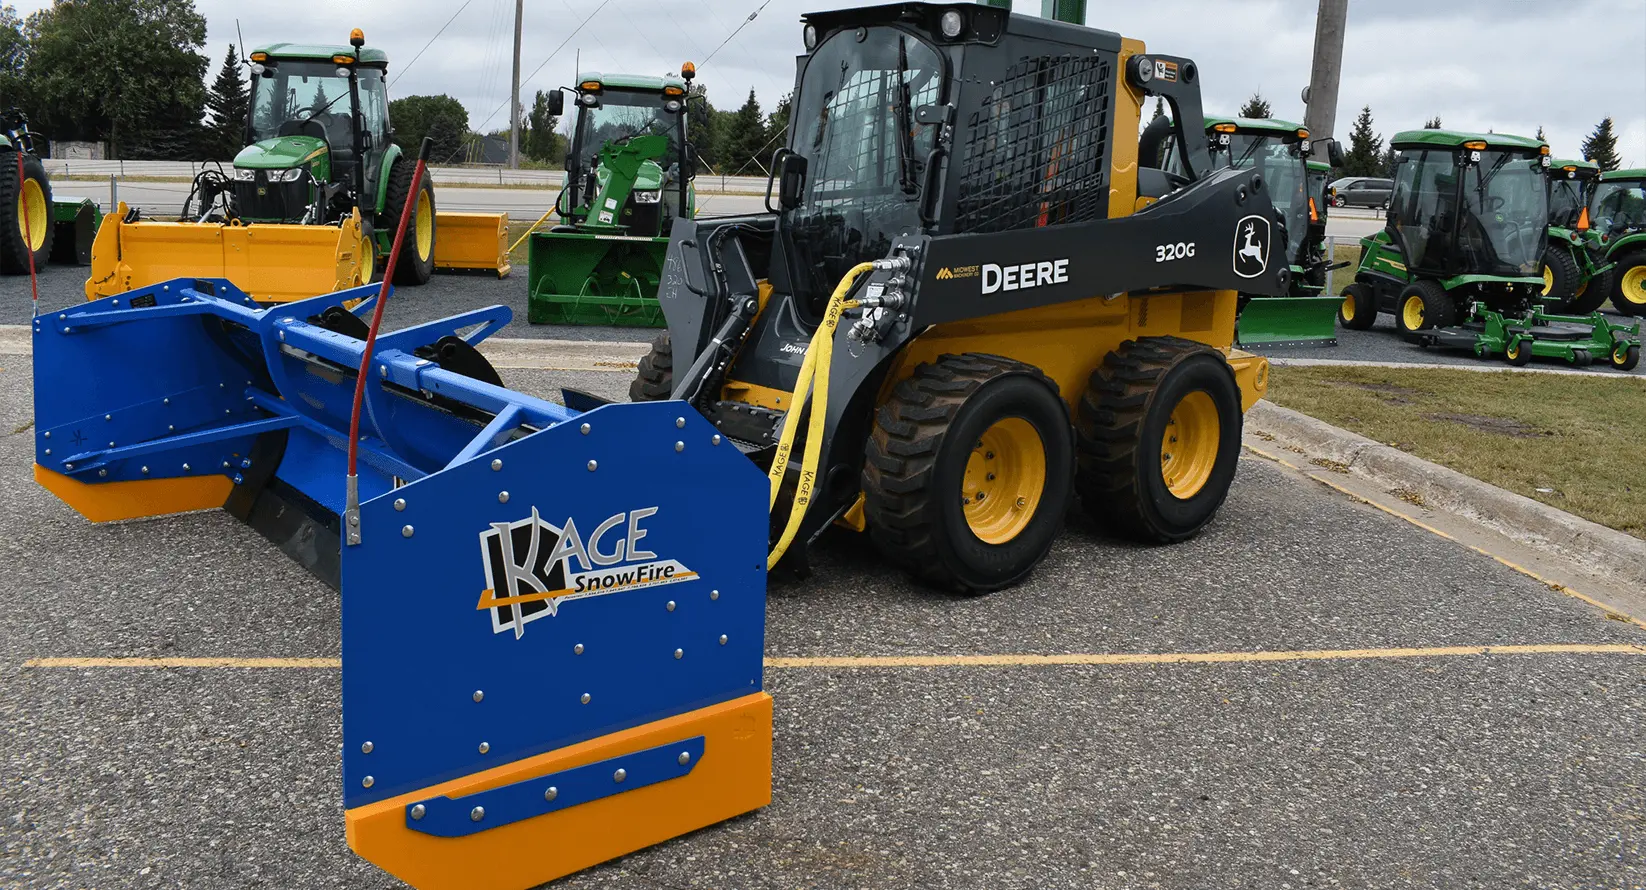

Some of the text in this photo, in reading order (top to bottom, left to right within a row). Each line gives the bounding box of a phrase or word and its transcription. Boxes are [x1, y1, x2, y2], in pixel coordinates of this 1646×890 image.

[1156, 242, 1195, 262] 320G
[982, 259, 1069, 294] DEERE
[829, 297, 841, 319] KAGE
[780, 343, 805, 355] JOHN
[772, 453, 786, 477] KAGE
[801, 470, 814, 496] KAGE
[489, 505, 658, 640] KAGE
[575, 564, 675, 593] SnowFire
